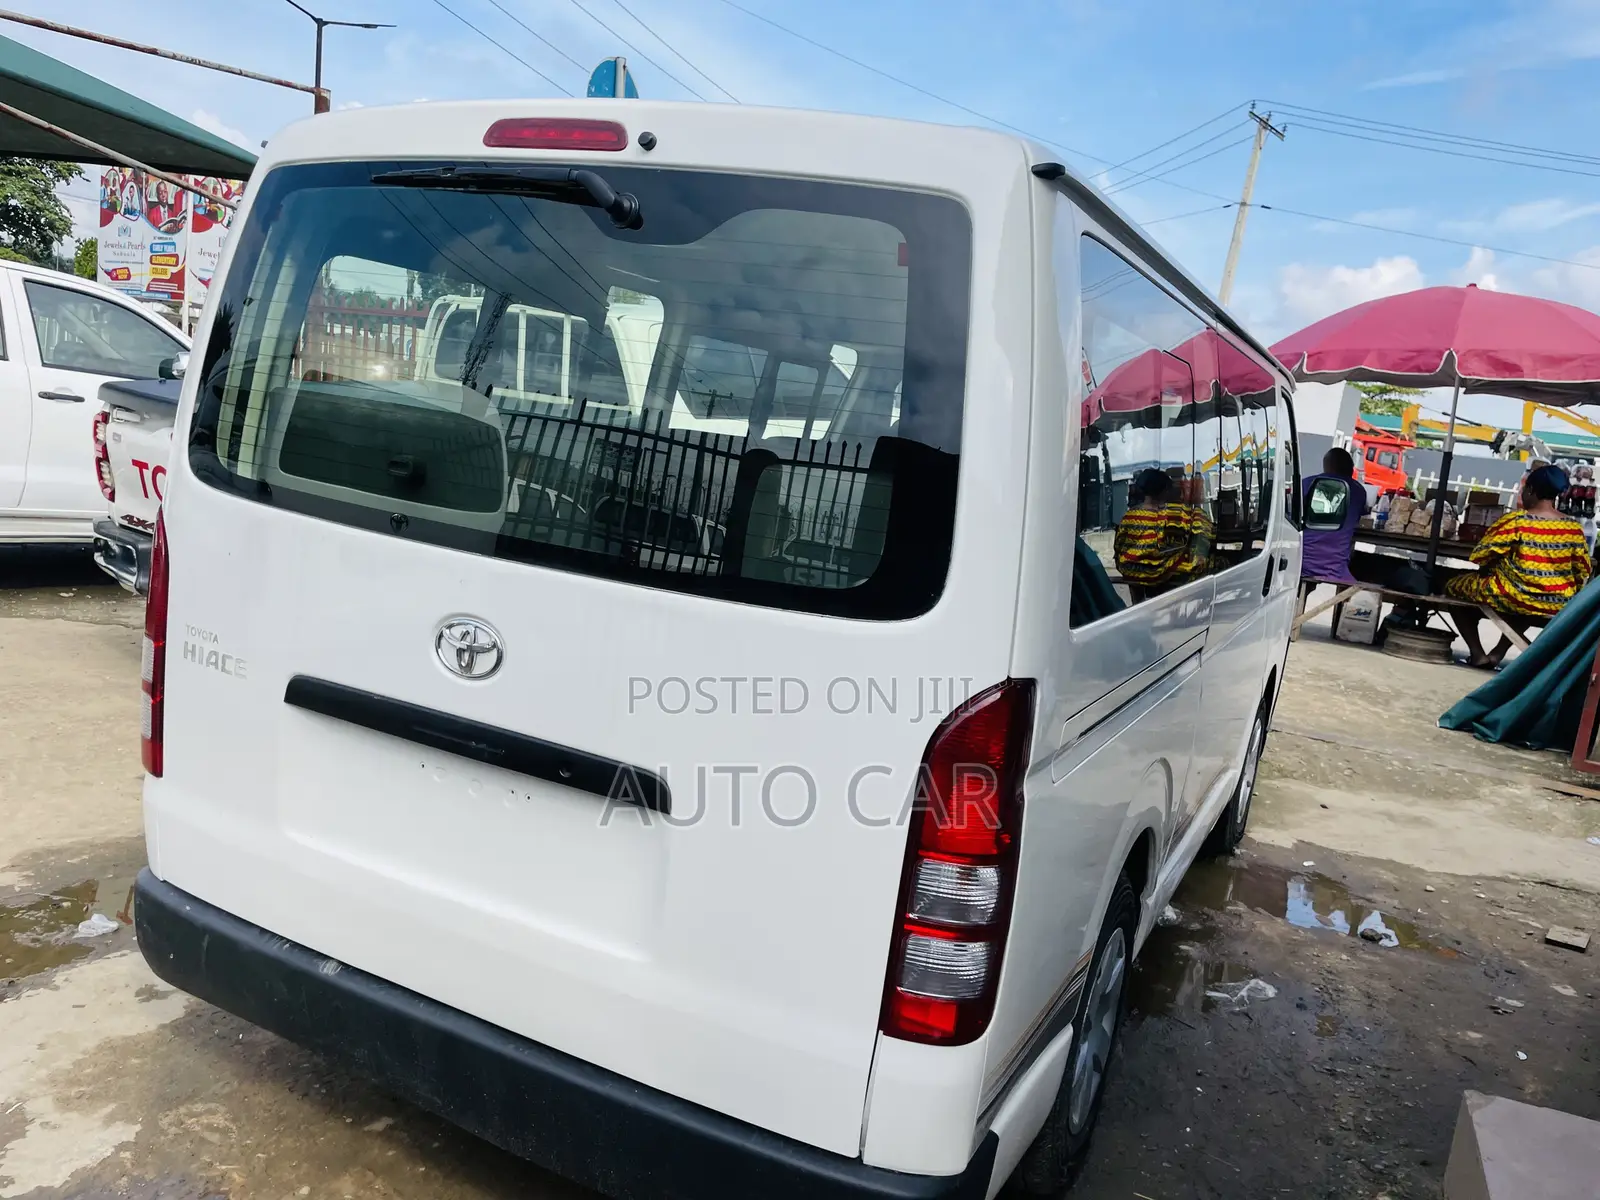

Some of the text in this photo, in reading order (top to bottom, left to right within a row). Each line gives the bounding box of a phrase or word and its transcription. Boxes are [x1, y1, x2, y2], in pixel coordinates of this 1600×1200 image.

[104, 240, 122, 249] Jewels
[127, 241, 146, 251] Pearls
[185, 622, 219, 645] TOYOTA
[183, 640, 248, 680] HIACE
